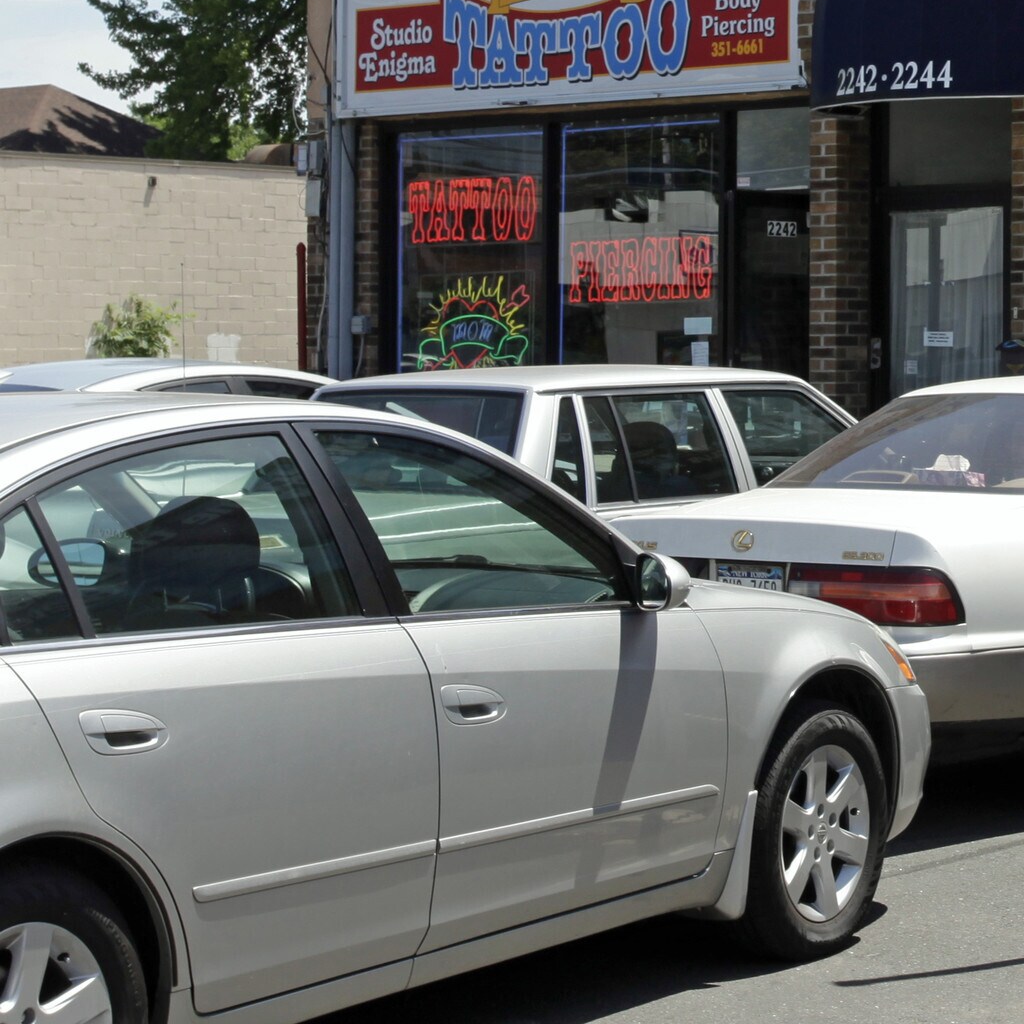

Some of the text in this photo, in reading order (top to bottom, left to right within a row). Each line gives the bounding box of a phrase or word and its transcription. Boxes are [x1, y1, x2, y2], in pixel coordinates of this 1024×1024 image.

[370, 17, 433, 50] Studio
[701, 13, 776, 38] Piercing
[711, 38, 764, 57] 351-6661
[358, 51, 436, 82] Enigma
[408, 175, 538, 243] TATTOO
[768, 221, 797, 237] 2242
[569, 235, 713, 303] PIERCING
